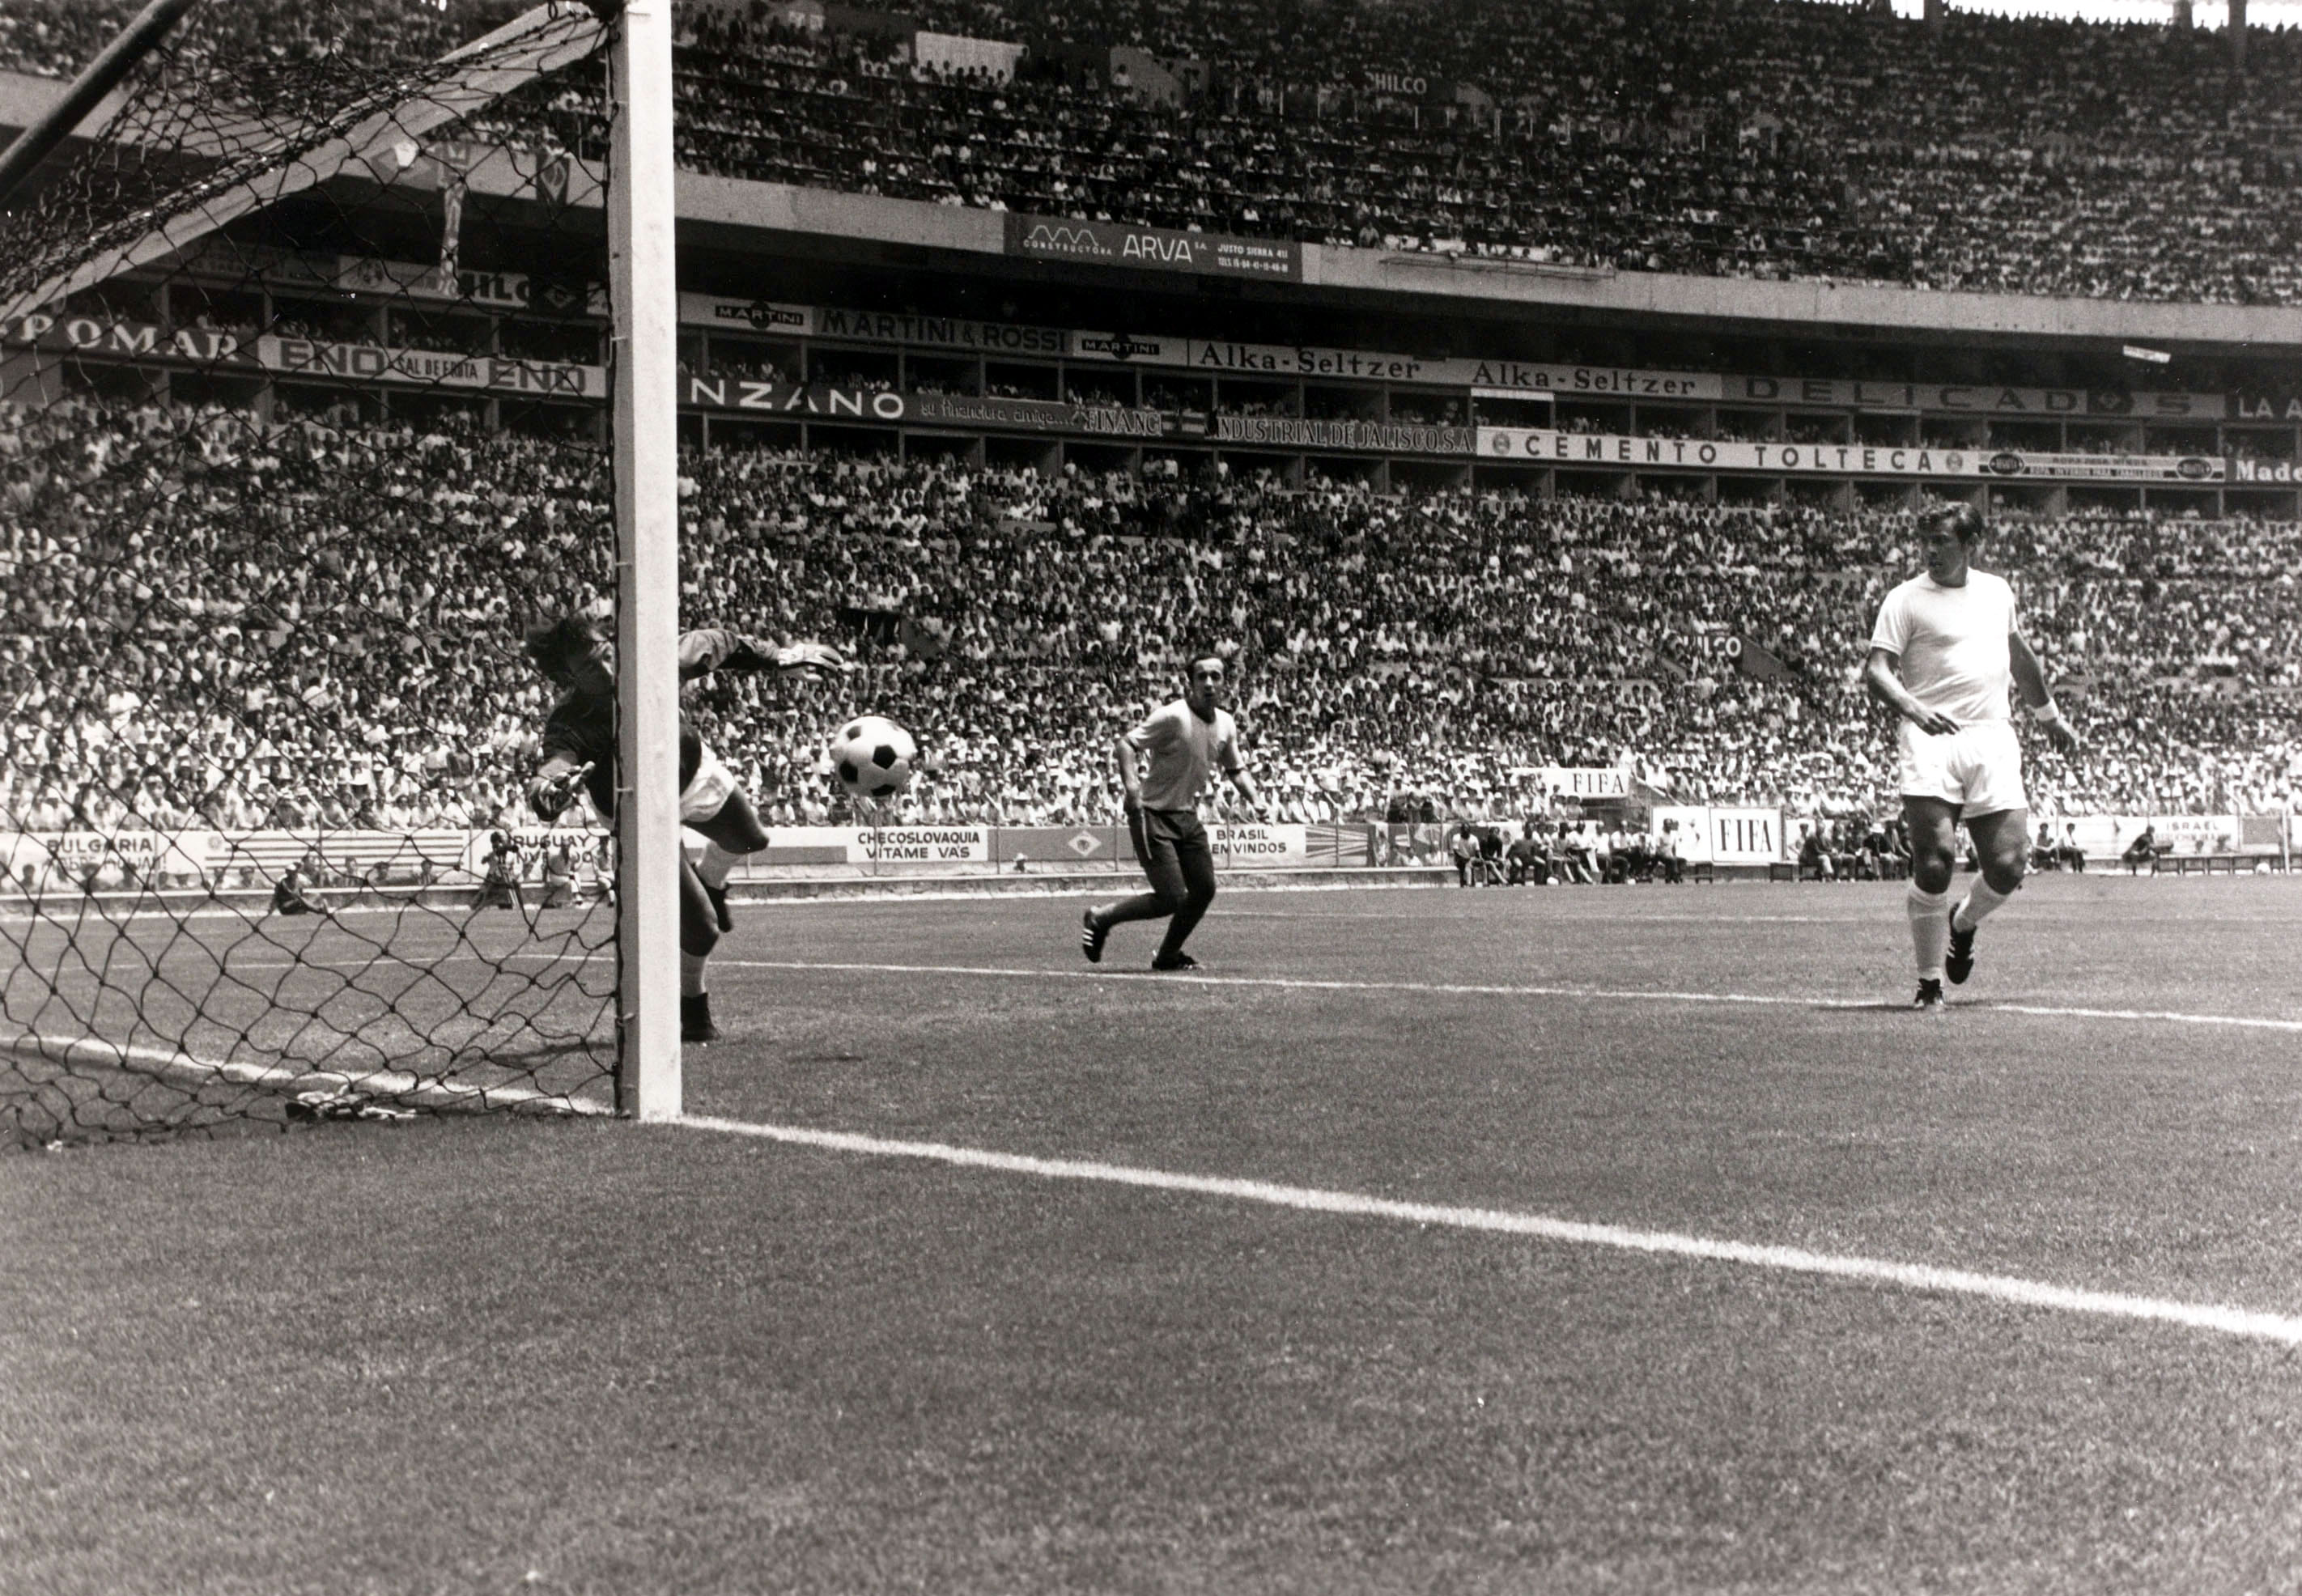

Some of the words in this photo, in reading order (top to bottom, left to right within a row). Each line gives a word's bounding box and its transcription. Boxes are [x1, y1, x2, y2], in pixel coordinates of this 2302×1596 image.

[1023, 239, 1112, 256] CONSTRUCTORA
[1123, 234, 1192, 263] ARVA
[719, 308, 801, 324] MARTINI
[822, 310, 955, 344] MARTINI
[983, 324, 1065, 351] ROSSI
[279, 340, 386, 376] ENO
[1085, 340, 1156, 354] MARTINI
[425, 359, 439, 376] DE
[1200, 343, 1421, 379] Alka-Seltzer
[488, 360, 586, 393] ENO
[1472, 362, 1696, 395] Alka-Seltzer
[1746, 376, 2191, 414] DELICADS
[2238, 397, 2274, 418] LA
[1330, 422, 1357, 448] DE
[1526, 435, 1717, 465] CEMENTO
[1755, 446, 1932, 472] TOLTECA
[1574, 773, 1625, 793] FIFA
[1217, 830, 1269, 840] BRASIL
[1720, 817, 1773, 852] FIFA
[2167, 821, 2219, 830] ISRAEL
[47, 838, 153, 854] BULGRIA
[858, 832, 980, 844] CHECOSLOVAQUIA
